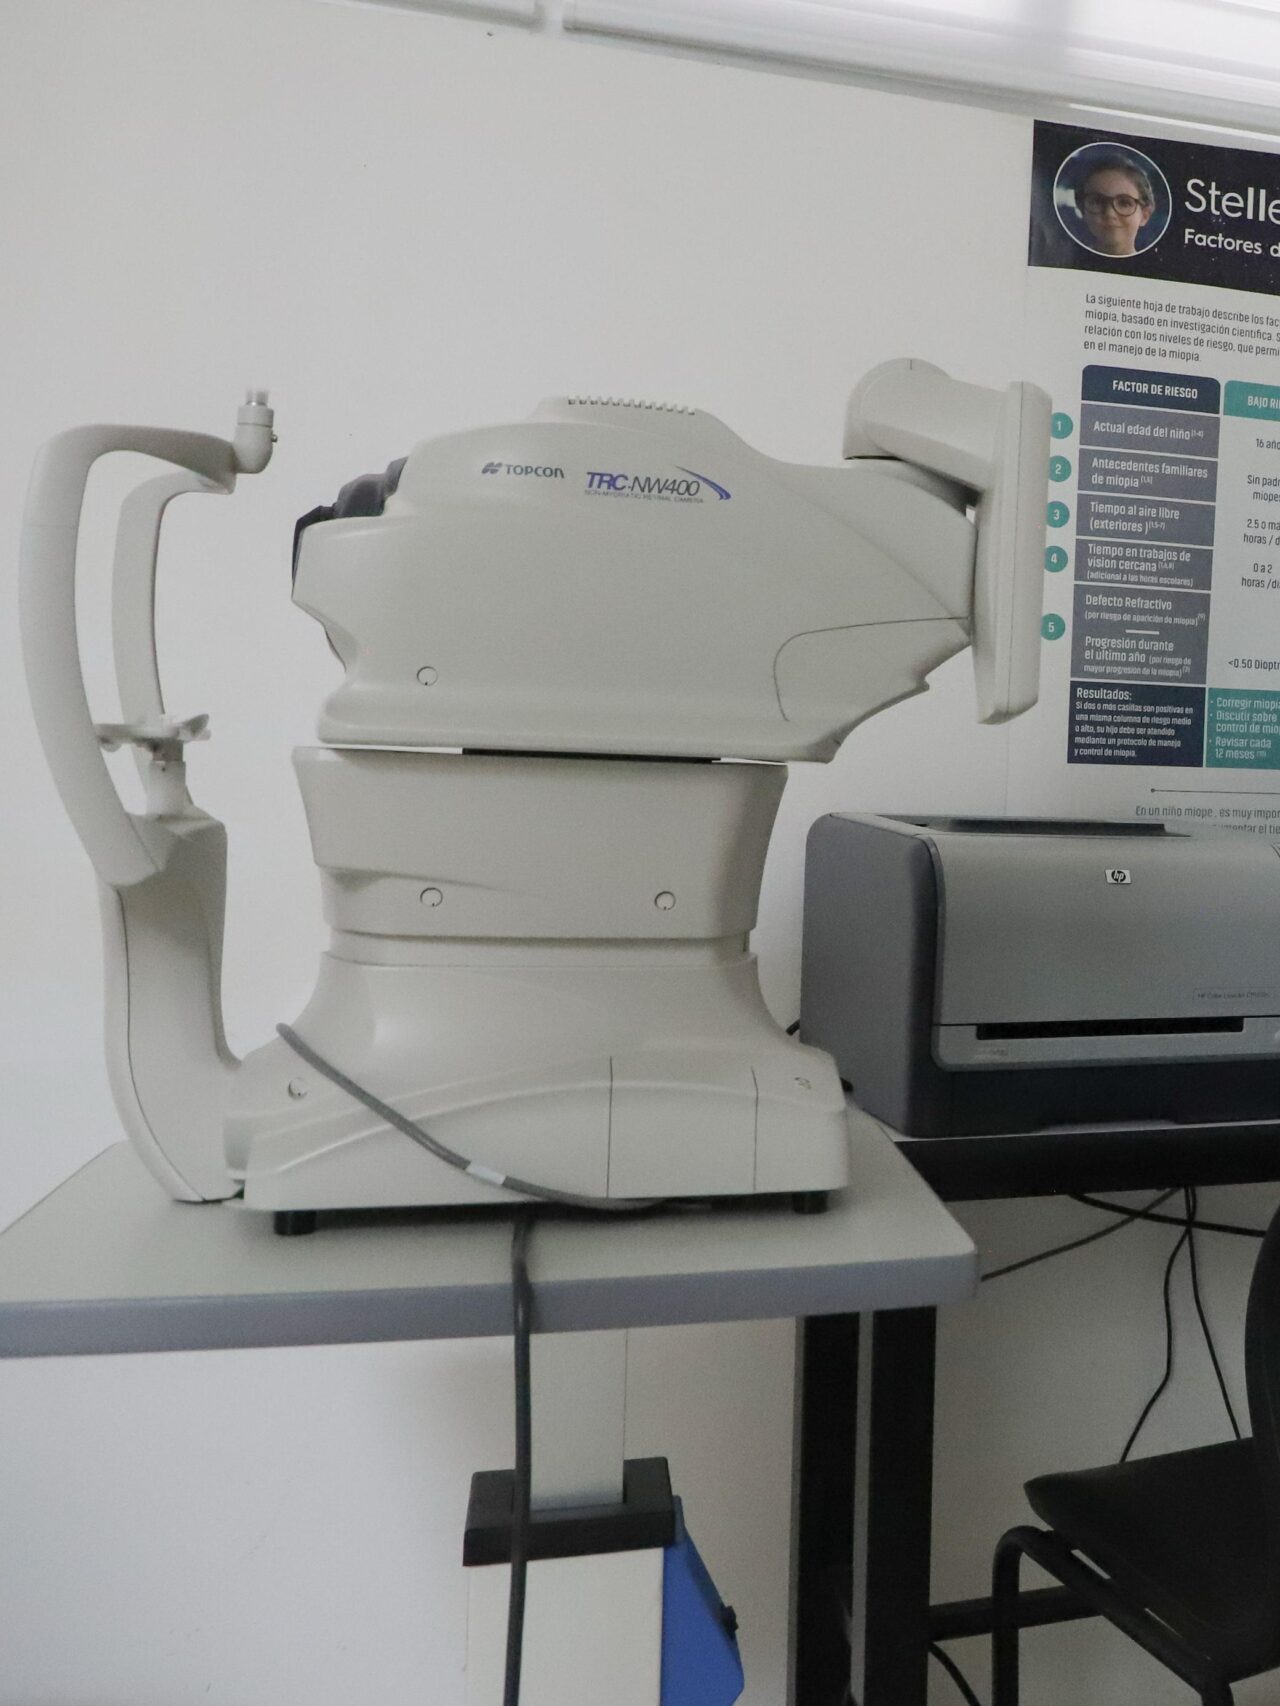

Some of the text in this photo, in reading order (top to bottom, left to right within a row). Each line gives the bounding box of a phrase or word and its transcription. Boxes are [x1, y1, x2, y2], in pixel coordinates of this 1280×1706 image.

[1184, 228, 1262, 254] Factores
[1086, 293, 1096, 305] La
[1098, 295, 1141, 310] siguiente
[1143, 300, 1163, 315] hoja
[1165, 303, 1176, 315] de
[1178, 305, 1210, 321] trabajo
[1212, 309, 1250, 324] describe
[1251, 314, 1264, 326] los
[1121, 312, 1154, 327] basado
[1156, 319, 1168, 328] en
[1124, 329, 1141, 339] con
[1143, 329, 1157, 341] los
[1159, 331, 1191, 345] niveles
[1193, 334, 1204, 346] de
[1206, 336, 1235, 352] riesgo,
[1237, 342, 1253, 353] que
[1083, 340, 1167, 358] en el manejo de la
[1112, 380, 1198, 399] FACTOR DE RIESGO
[1247, 396, 1268, 408] BAJO
[1056, 421, 1062, 432] 1
[1093, 421, 1190, 440] Actual edad del niño
[1256, 437, 1264, 449] 16
[505, 464, 565, 478] TOPCON
[1055, 464, 1062, 474] 2
[1092, 457, 1207, 478] Antecedentes familiares
[1091, 473, 1104, 485] de
[1247, 474, 1260, 486] Sin
[1053, 510, 1060, 520] 3
[1090, 502, 1179, 519] Tiempo al aire libre
[1243, 533, 1267, 545] horas
[1088, 543, 1191, 562] Tiempo en trabajos de
[1051, 554, 1058, 564] 4
[1118, 561, 1156, 572] cercana
[1253, 562, 1272, 574] 0 a 2
[1241, 576, 1265, 588] horas
[1085, 594, 1172, 610] Defecto Refractivo
[1048, 622, 1055, 633] 5
[1138, 639, 1174, 651] durante
[1084, 649, 1094, 660] el
[1076, 687, 1132, 700] Resultados:
[1216, 696, 1252, 710] Corregir
[1216, 710, 1277, 722] Discutir sobre
[1216, 723, 1260, 733] control de
[1215, 737, 1271, 748] Revisar cada
[1215, 748, 1255, 759] 12 meses
